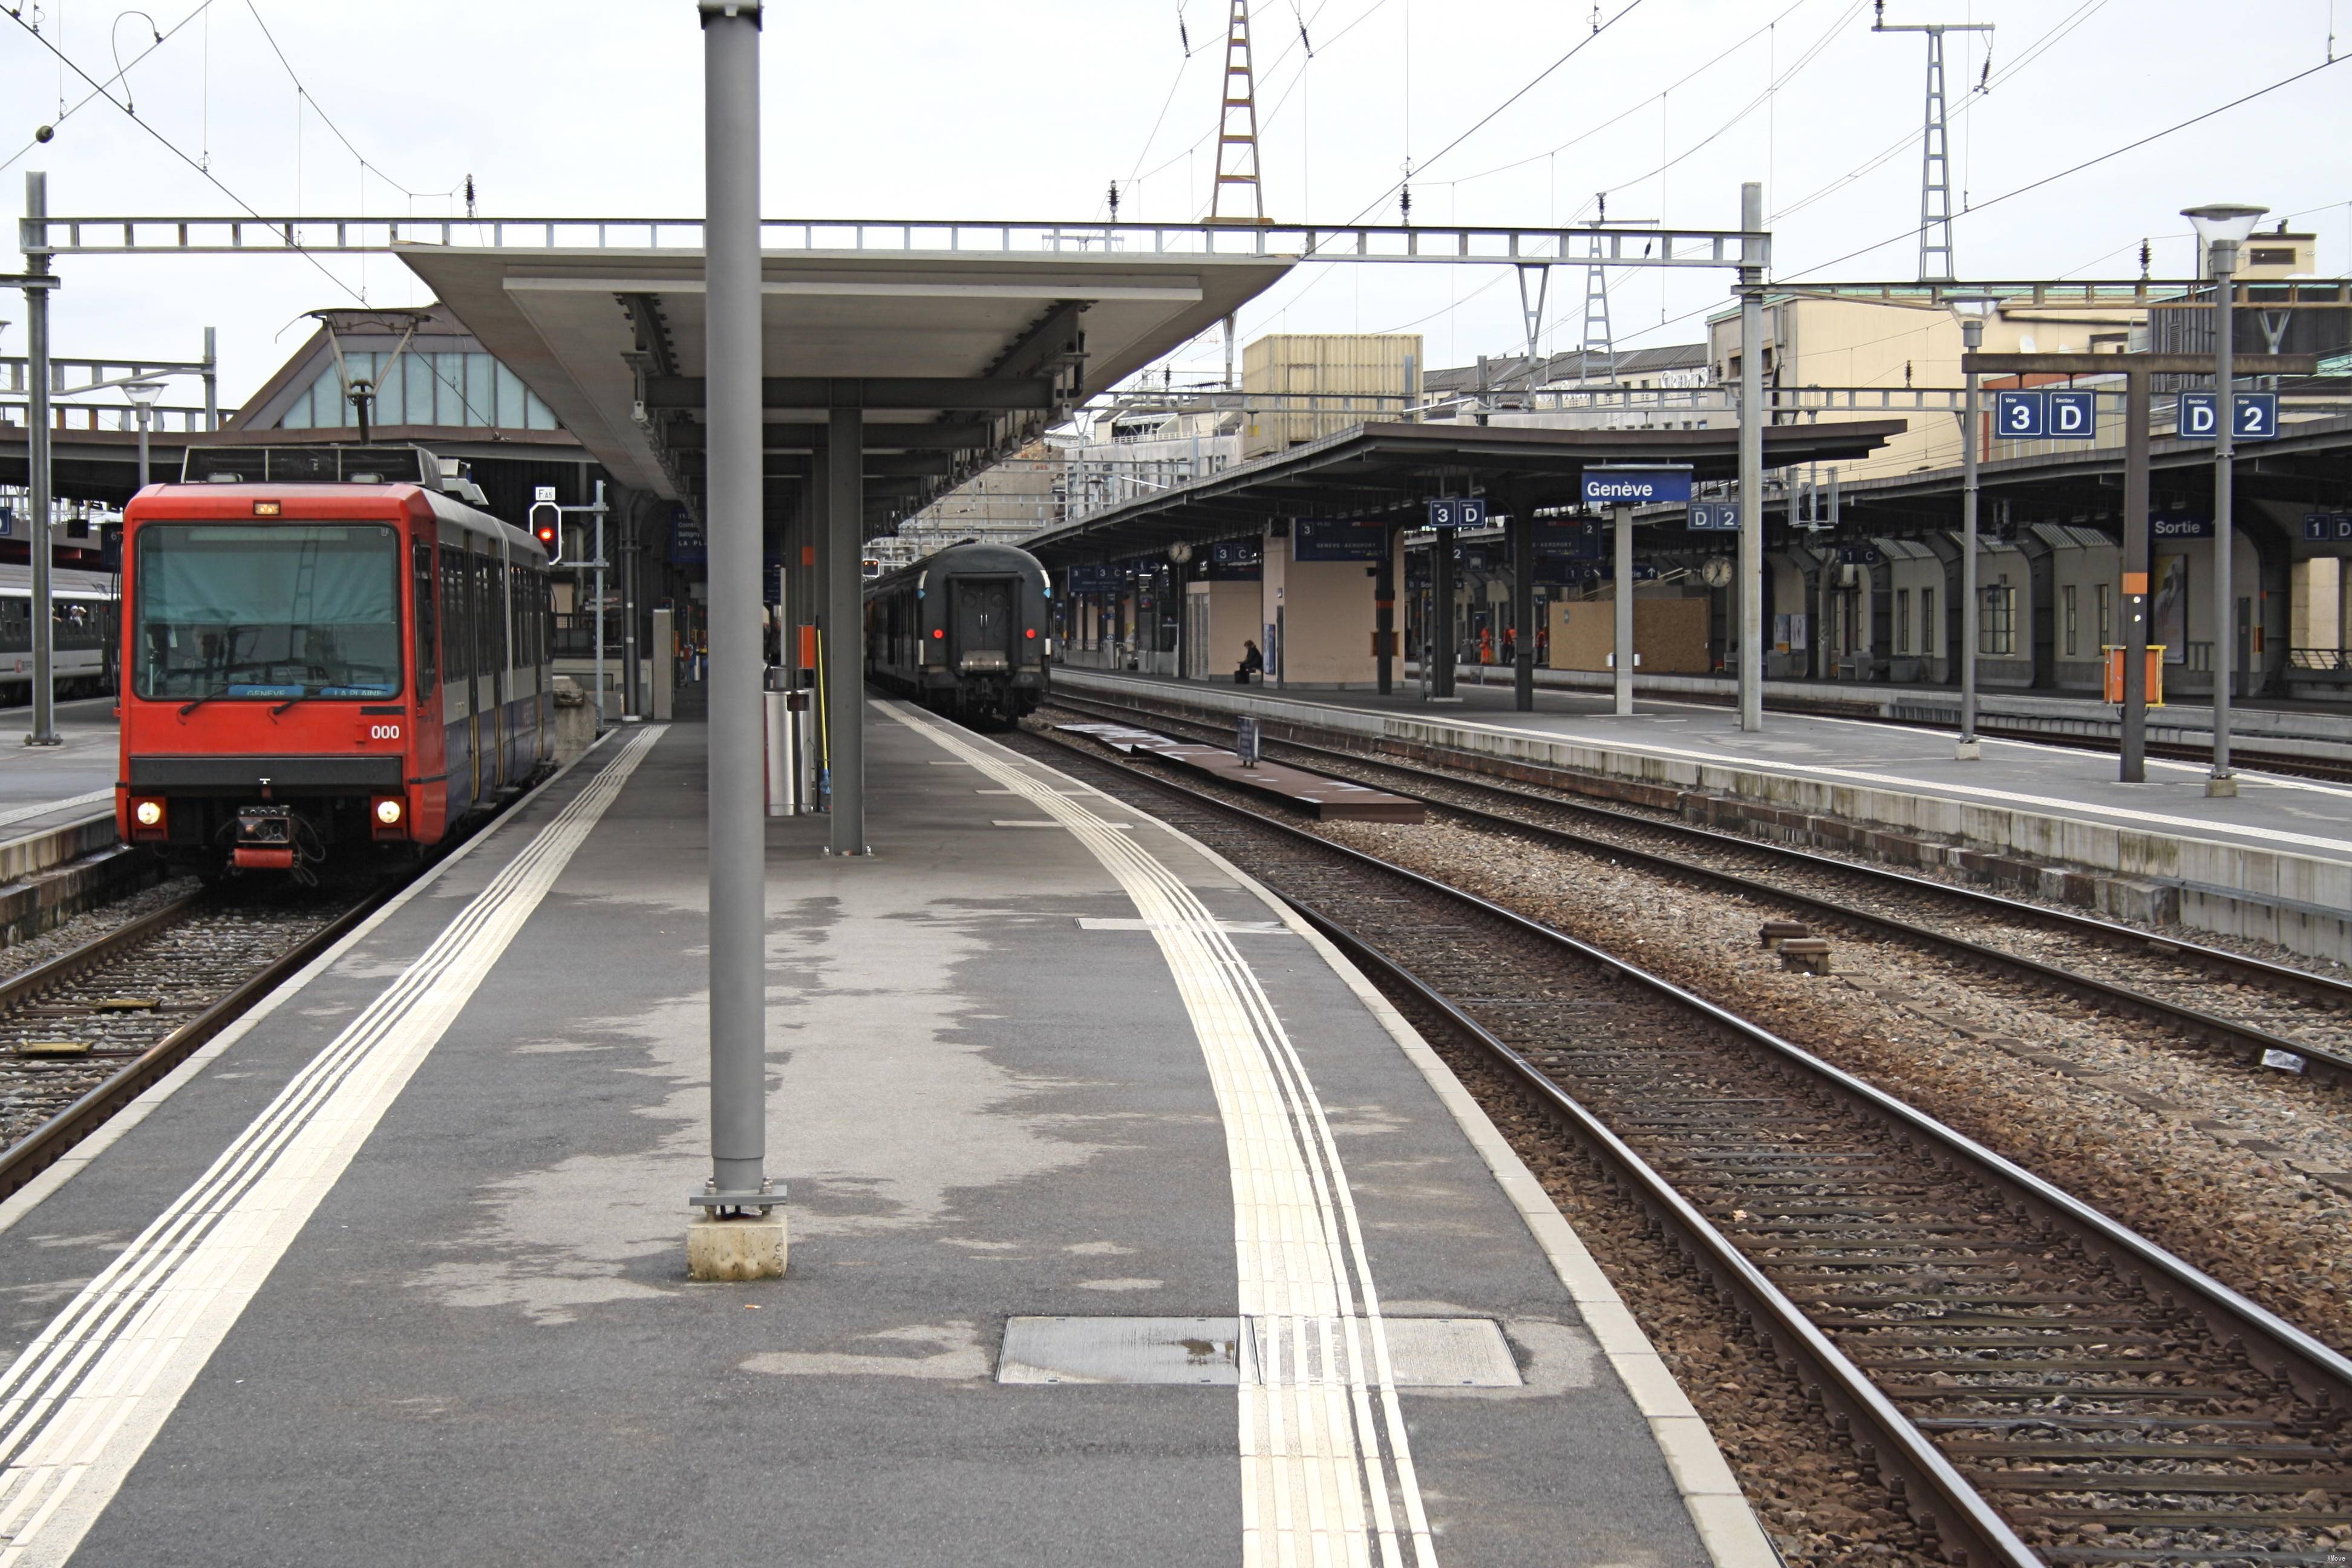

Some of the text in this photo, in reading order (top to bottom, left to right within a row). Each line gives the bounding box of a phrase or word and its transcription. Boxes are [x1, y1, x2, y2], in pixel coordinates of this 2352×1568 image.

[2011, 405, 2082, 430] 3 D
[2193, 407, 2262, 431] D 2
[1587, 481, 1653, 496] Genève
[1437, 508, 1477, 522] 3 D
[1695, 511, 1734, 526] D 2
[2155, 520, 2201, 534] Sortie
[2313, 522, 2351, 536] 1 D
[1220, 549, 1246, 559] 3 C
[1454, 549, 1461, 558] 2
[1847, 551, 1873, 561] 1 C
[371, 725, 400, 739] 000
